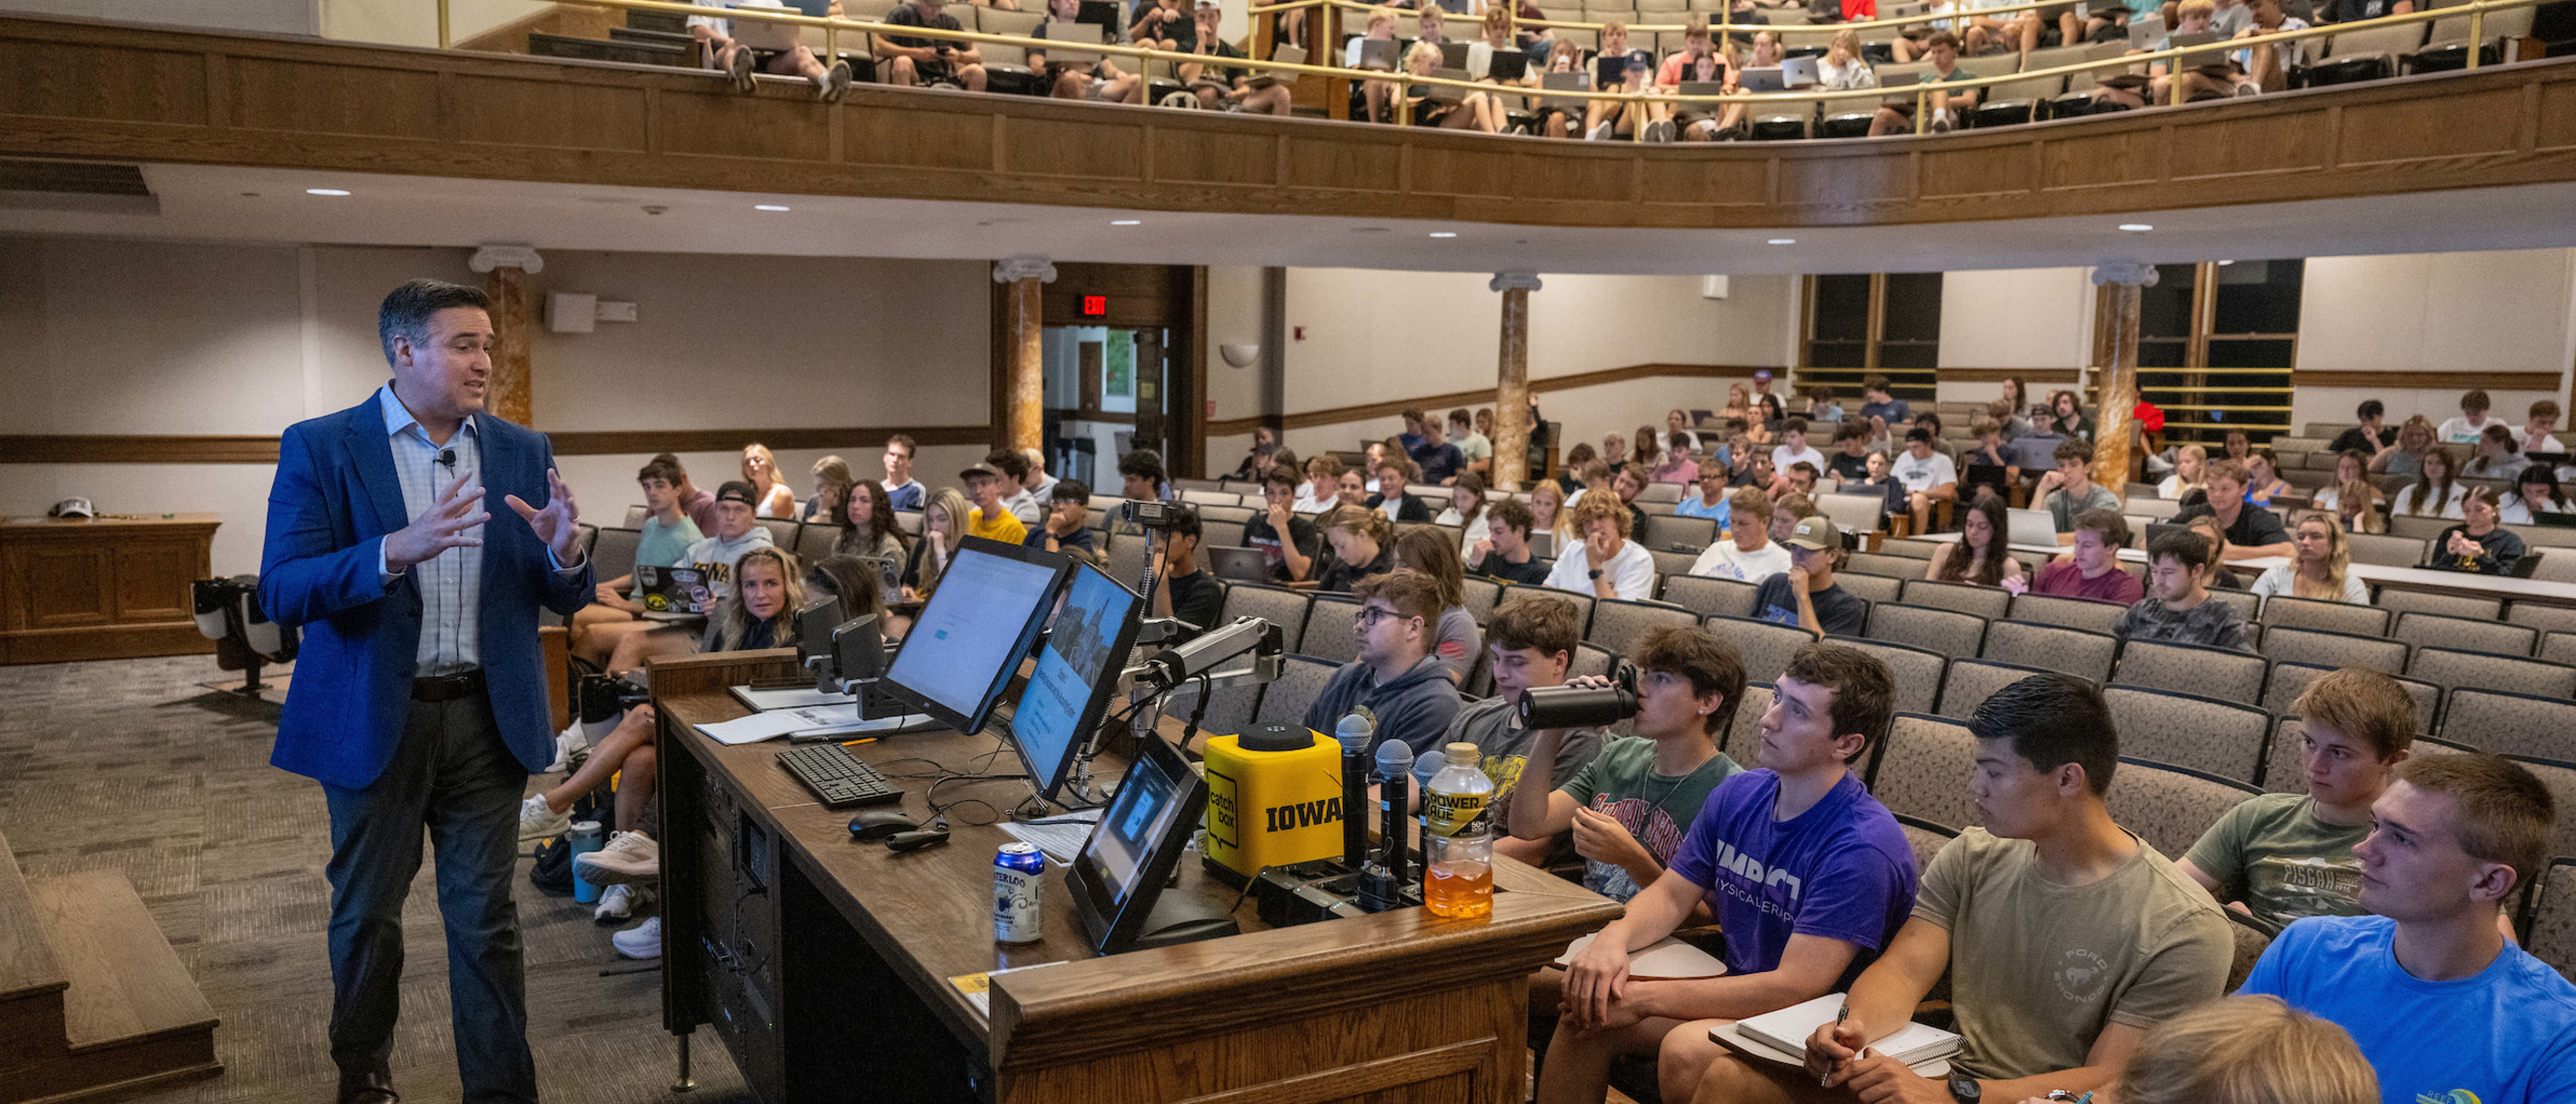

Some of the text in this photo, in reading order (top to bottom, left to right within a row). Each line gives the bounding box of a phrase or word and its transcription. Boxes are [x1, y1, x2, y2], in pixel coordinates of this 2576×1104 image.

[1209, 791, 1234, 814] catch
[1431, 794, 1479, 809] POWER
[1218, 808, 1234, 829] box
[1266, 797, 1343, 833] IOWA
[1643, 806, 1684, 866] SERIE
[1716, 839, 1801, 901] IMPCT
[2284, 865, 2335, 890] PISGAH
[2066, 949, 2108, 970] FORD
